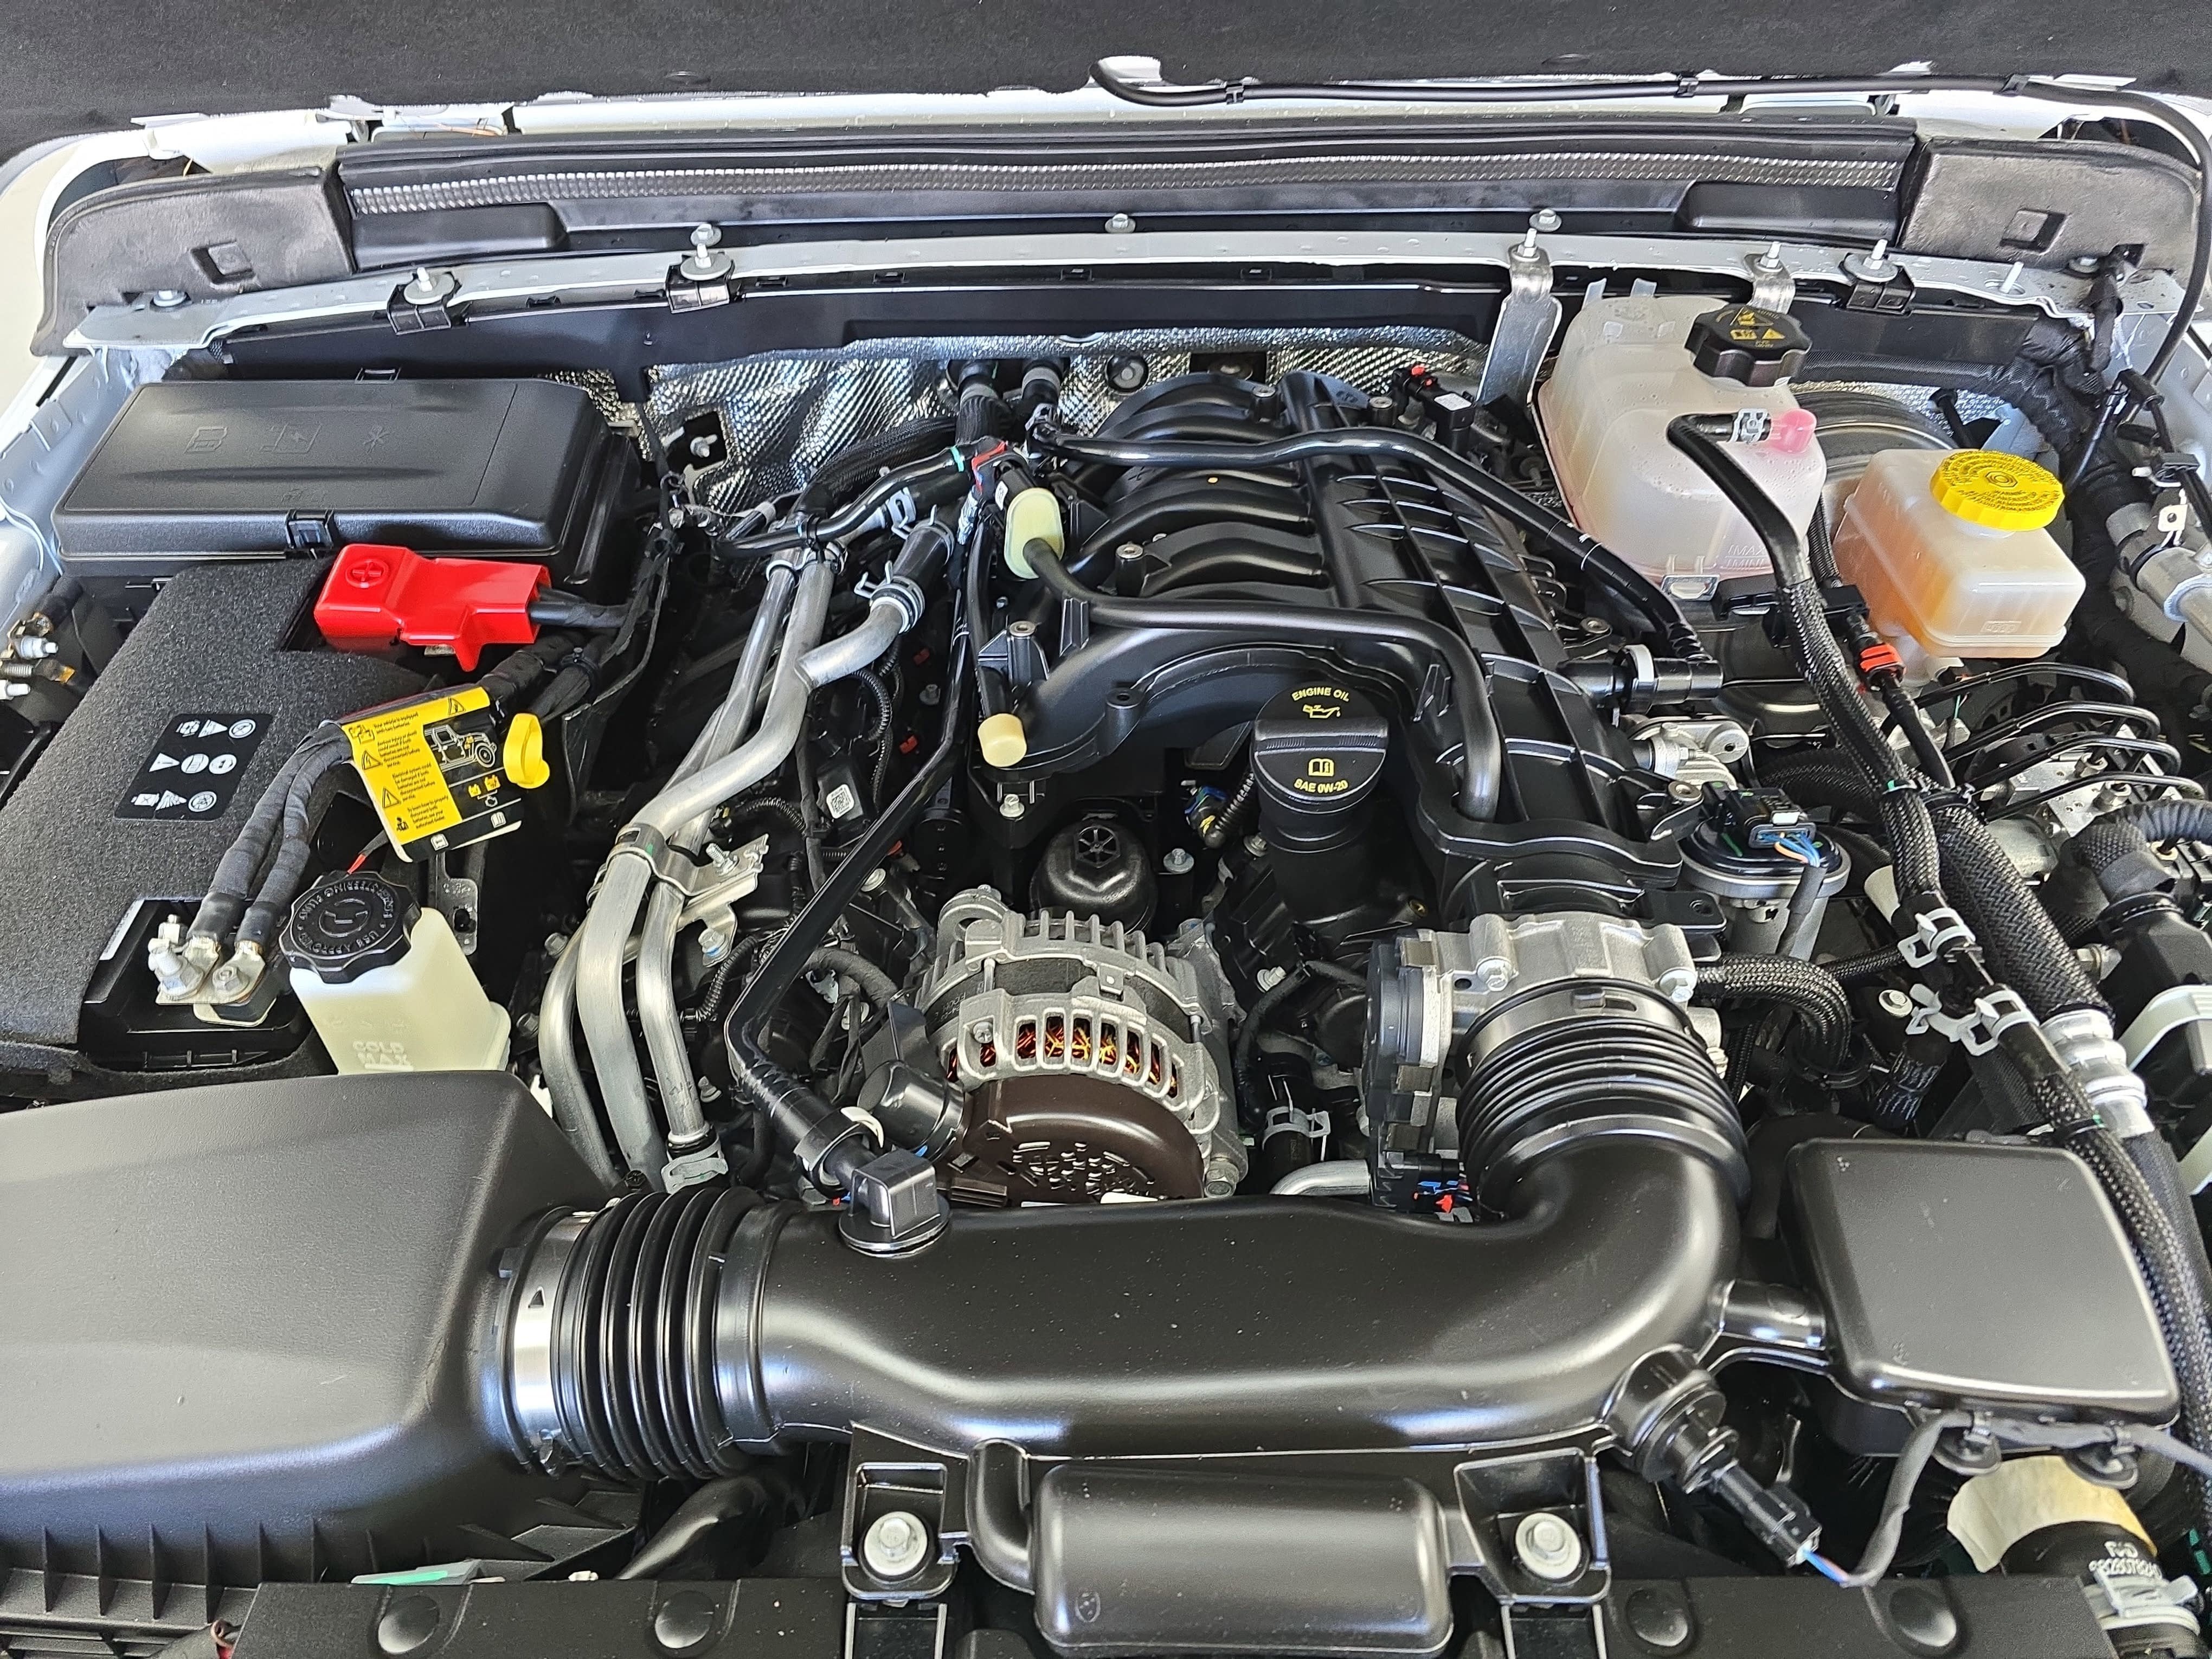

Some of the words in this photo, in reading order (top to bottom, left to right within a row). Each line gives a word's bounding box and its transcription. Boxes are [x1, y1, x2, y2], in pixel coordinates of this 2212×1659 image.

[1291, 687, 1331, 702] ENGINE
[1333, 690, 1349, 702] OIL
[1294, 778, 1316, 792] SAE
[1317, 780, 1349, 794] 0W-20
[324, 880, 378, 897] STEERING
[352, 1040, 404, 1053] COLD
[357, 1052, 411, 1065] MAX
